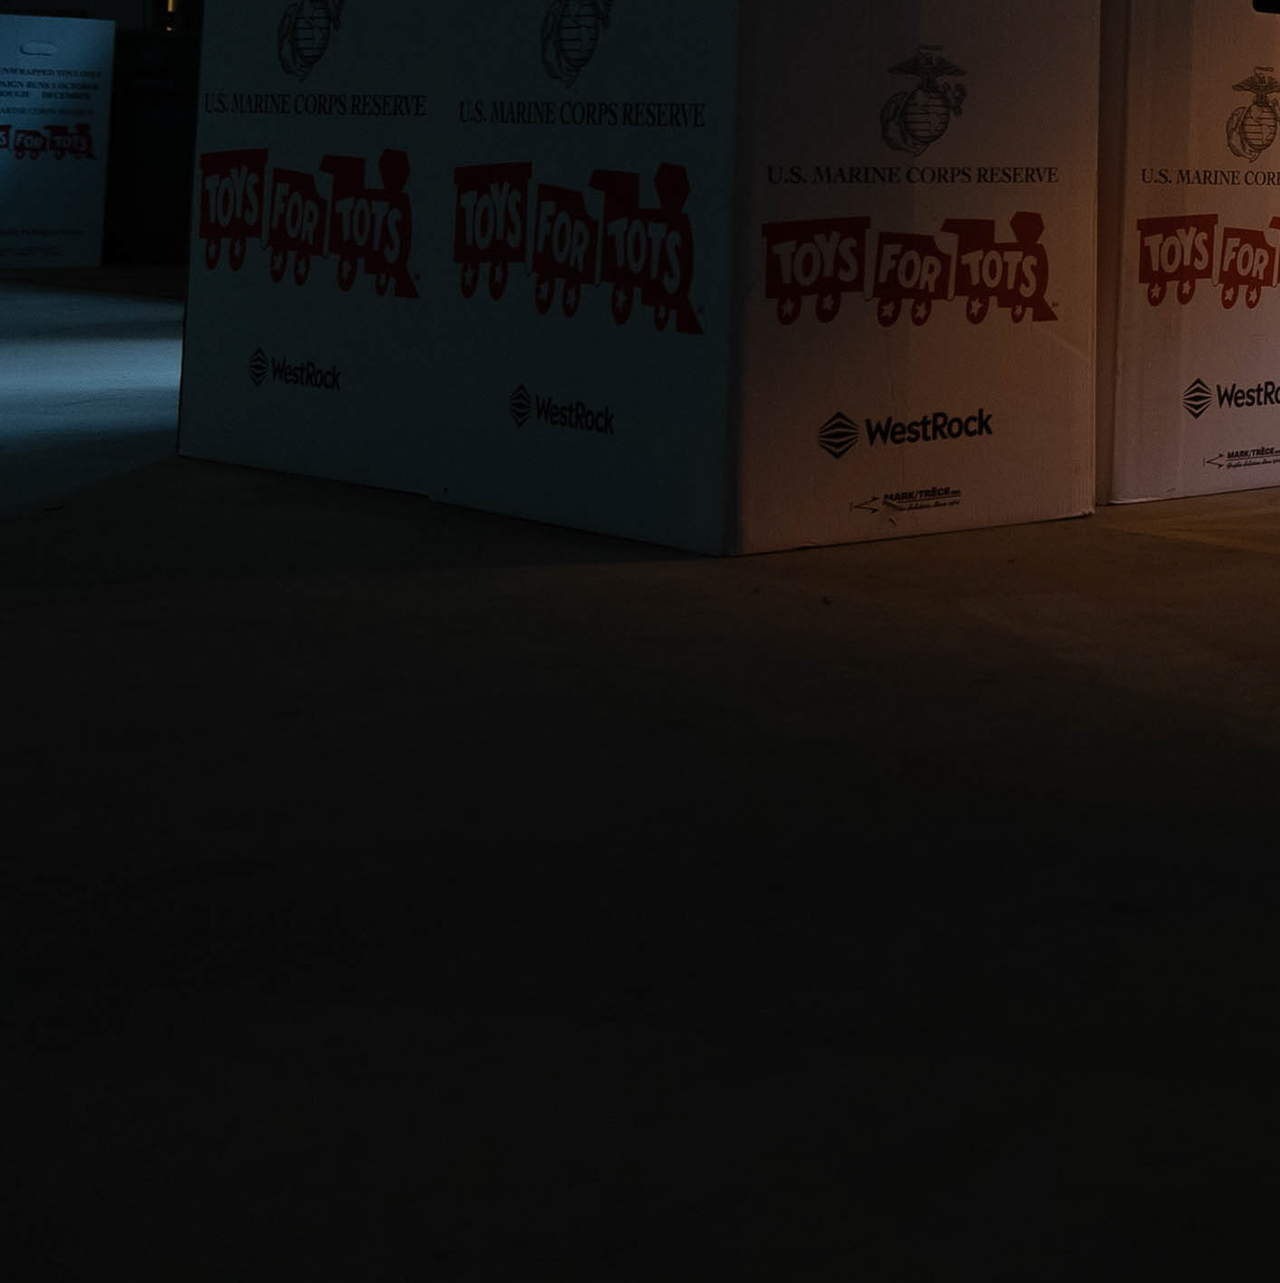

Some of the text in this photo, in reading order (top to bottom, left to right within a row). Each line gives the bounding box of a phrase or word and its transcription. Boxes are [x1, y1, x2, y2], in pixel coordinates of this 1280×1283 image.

[204, 93, 427, 117] U.S. MARINE CORPS RESERVE
[459, 101, 706, 128] U.S. MARINE CORPS RESERVE
[767, 166, 1060, 184] U.S. MARINE CORPS RESERVE
[1141, 169, 1172, 184] U.S.
[1176, 170, 1241, 186] MARINE
[205, 166, 400, 264] TOYS FOR TOTS
[461, 183, 681, 294] TOYS FOR TOTS
[1144, 226, 1209, 274] TOYS
[1223, 237, 1269, 280] FOR
[770, 229, 1037, 299] TOYS FOR TOTS
[272, 357, 341, 389] WestRock
[536, 396, 614, 434] WestRock
[865, 408, 993, 446] WestRock
